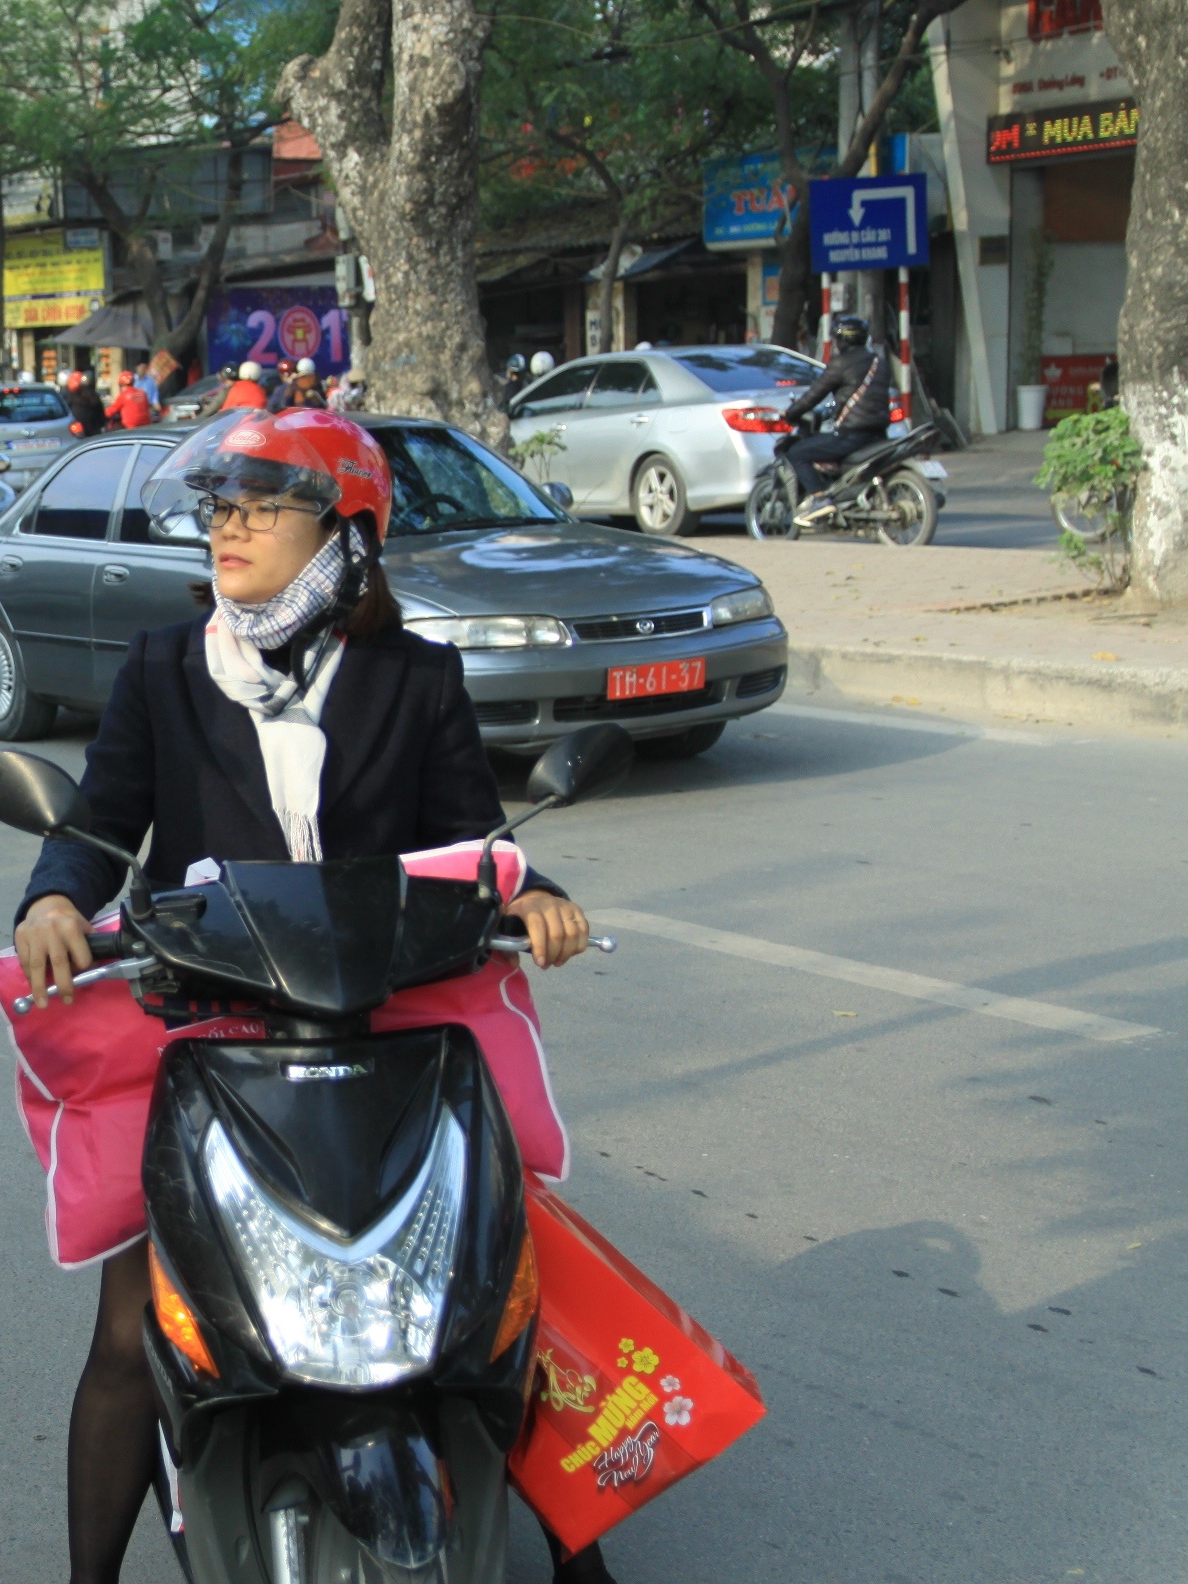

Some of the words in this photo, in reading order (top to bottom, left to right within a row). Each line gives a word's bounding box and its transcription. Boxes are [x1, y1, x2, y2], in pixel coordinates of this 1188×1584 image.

[1042, 115, 1095, 145] MUA
[288, 1063, 368, 1082] HONDA
[560, 1443, 601, 1474] CHÚC
[587, 1375, 651, 1448] MỪNG
[593, 1436, 635, 1470] Happy
[597, 1455, 639, 1487] New
